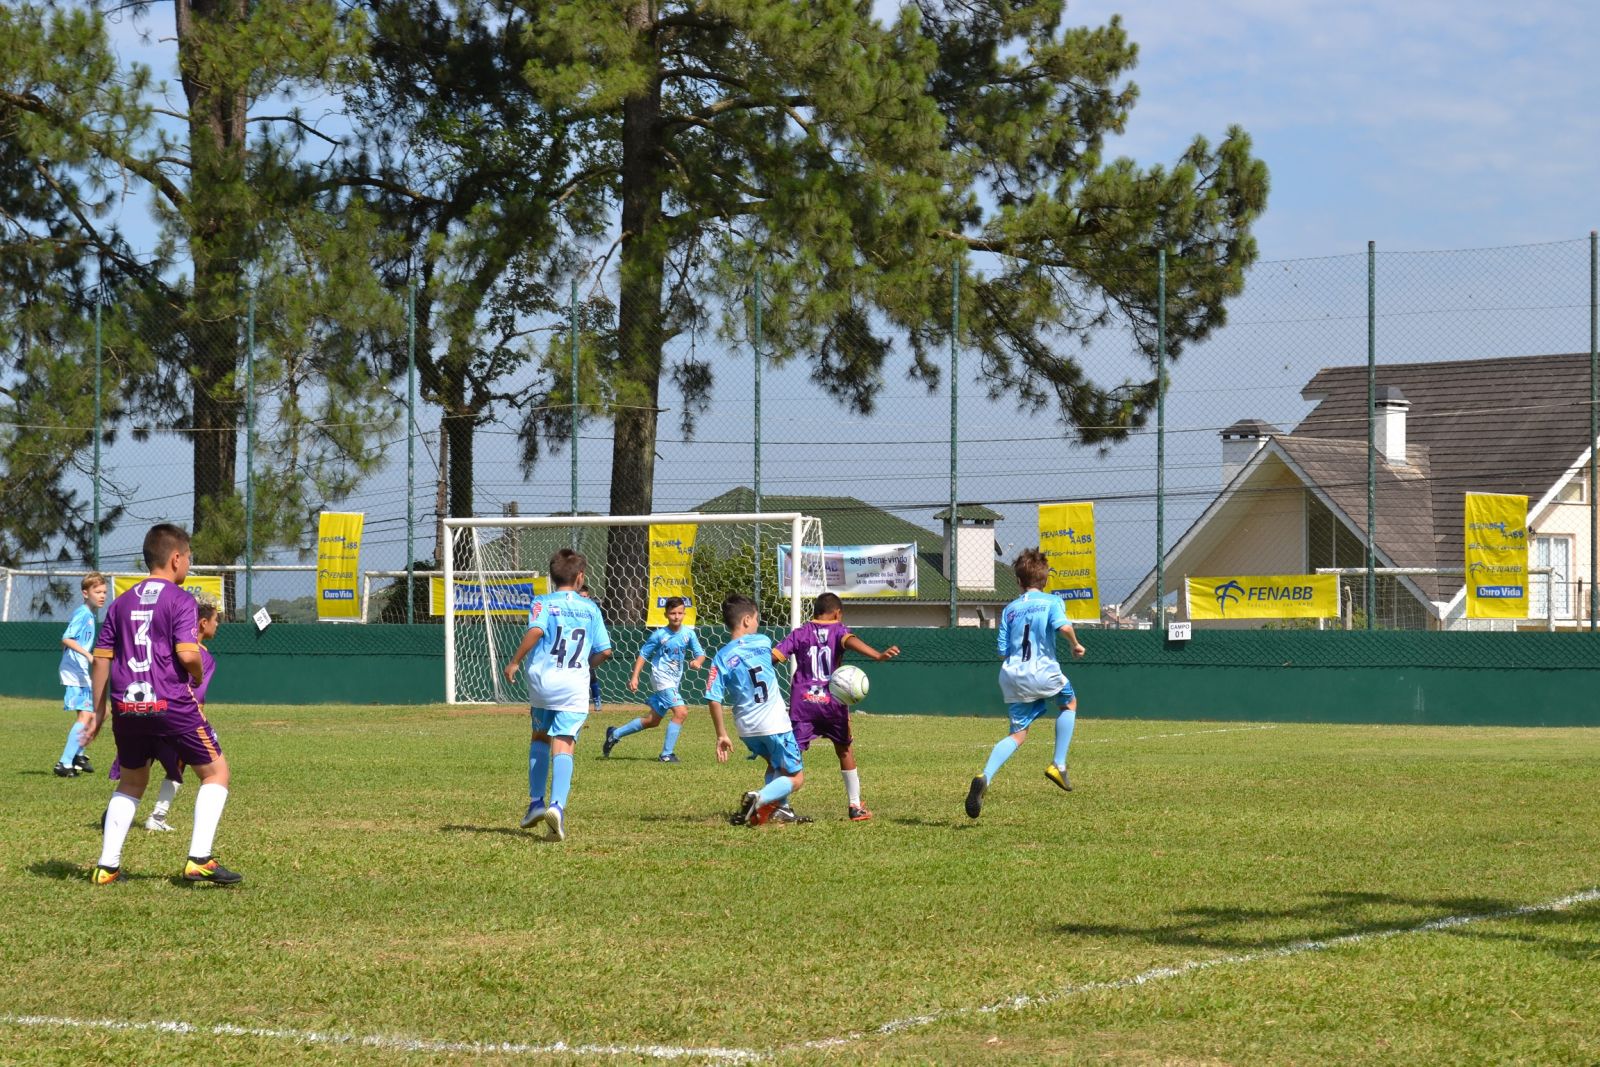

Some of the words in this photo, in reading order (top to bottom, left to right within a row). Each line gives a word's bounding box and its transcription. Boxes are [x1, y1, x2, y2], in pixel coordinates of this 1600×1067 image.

[850, 557, 866, 566] Seja
[325, 590, 339, 598] Ouro
[340, 590, 352, 598] Vida
[1074, 588, 1092, 597] Vida
[1248, 586, 1313, 600] FENABB
[1479, 588, 1500, 596] Ouro
[1502, 588, 1520, 596] Vida
[1175, 630, 1184, 638] 01
[127, 610, 153, 673] 3
[550, 625, 585, 669] 42
[809, 645, 831, 683] 10
[748, 666, 768, 703] 5
